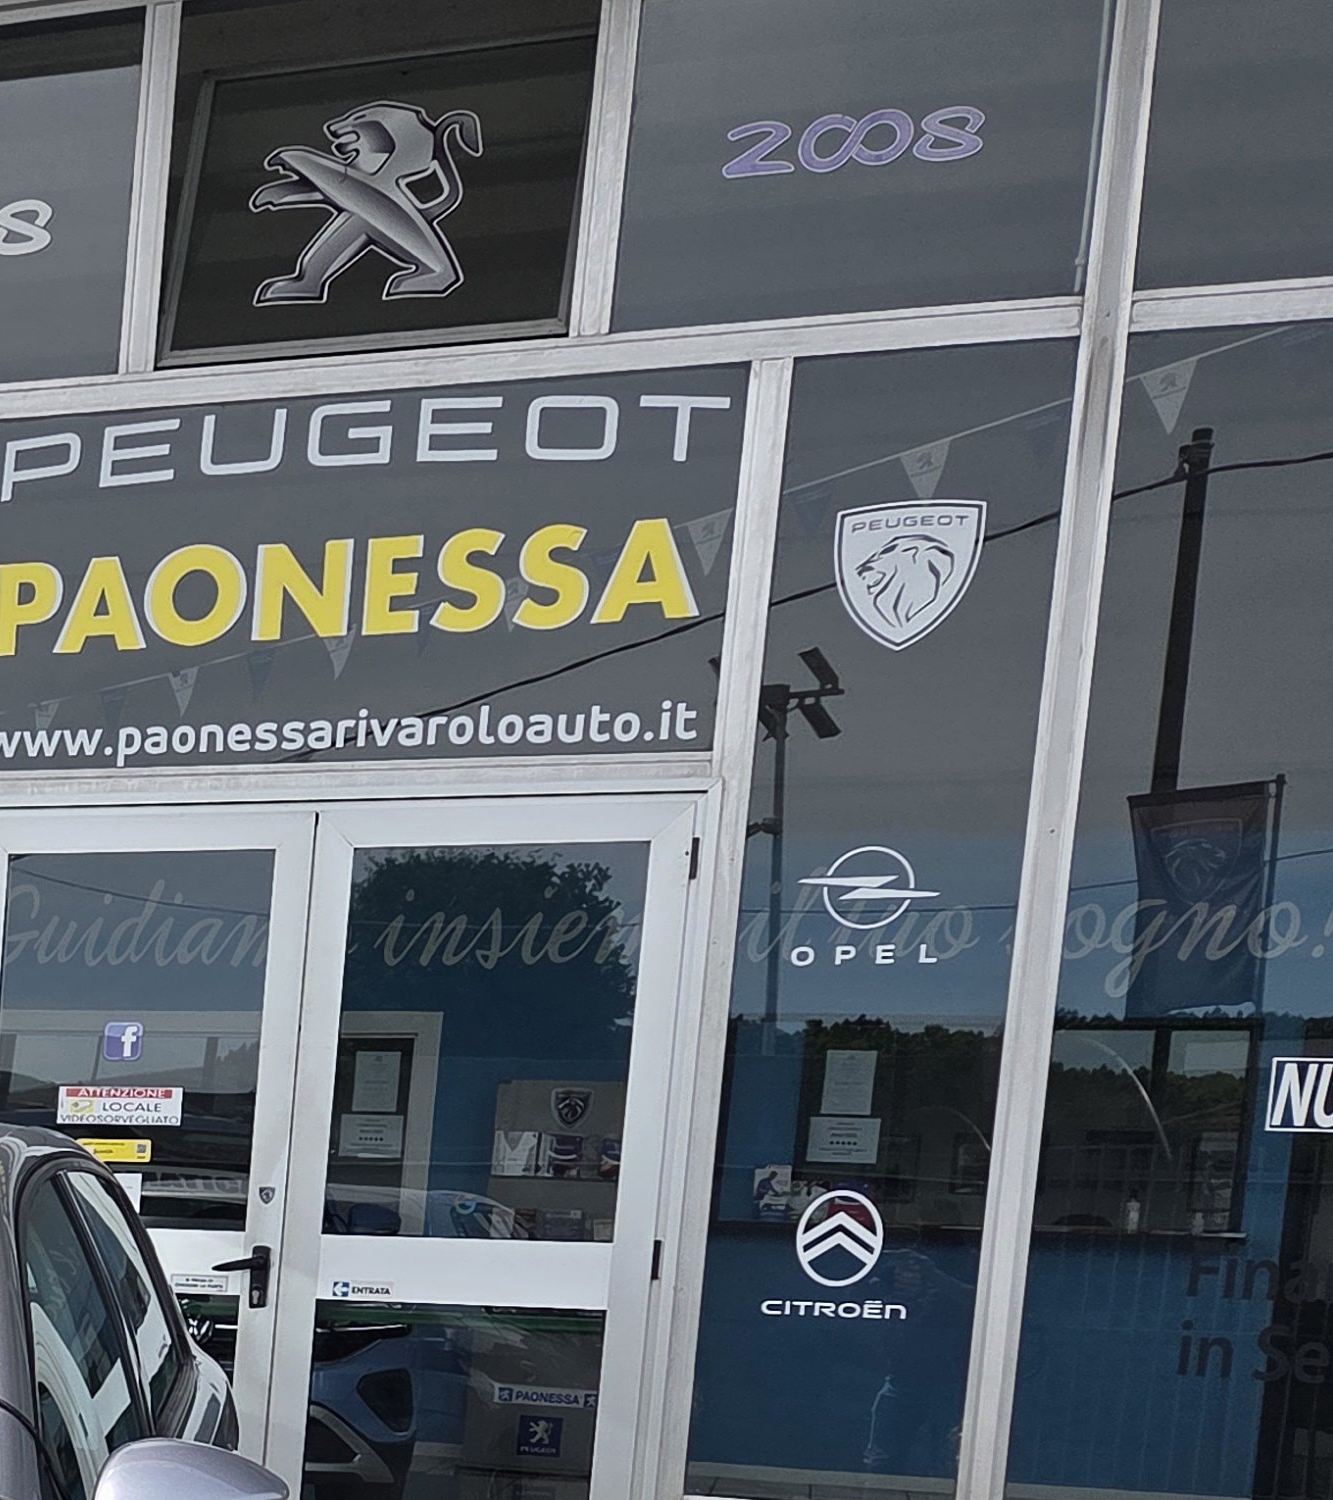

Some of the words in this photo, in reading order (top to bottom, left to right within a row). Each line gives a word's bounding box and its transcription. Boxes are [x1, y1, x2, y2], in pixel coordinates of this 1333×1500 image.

[721, 106, 986, 179] 2008
[0, 395, 732, 502] PEUGEOT
[850, 513, 970, 535] PEUGEOT
[790, 942, 938, 967] OPEL
[77, 1088, 166, 1099] ATTENZIONE
[102, 1102, 163, 1113] LOCALE
[60, 1114, 179, 1125] VIDEOSORVEGLIATO
[515, 1390, 580, 1406] PAONESSA
